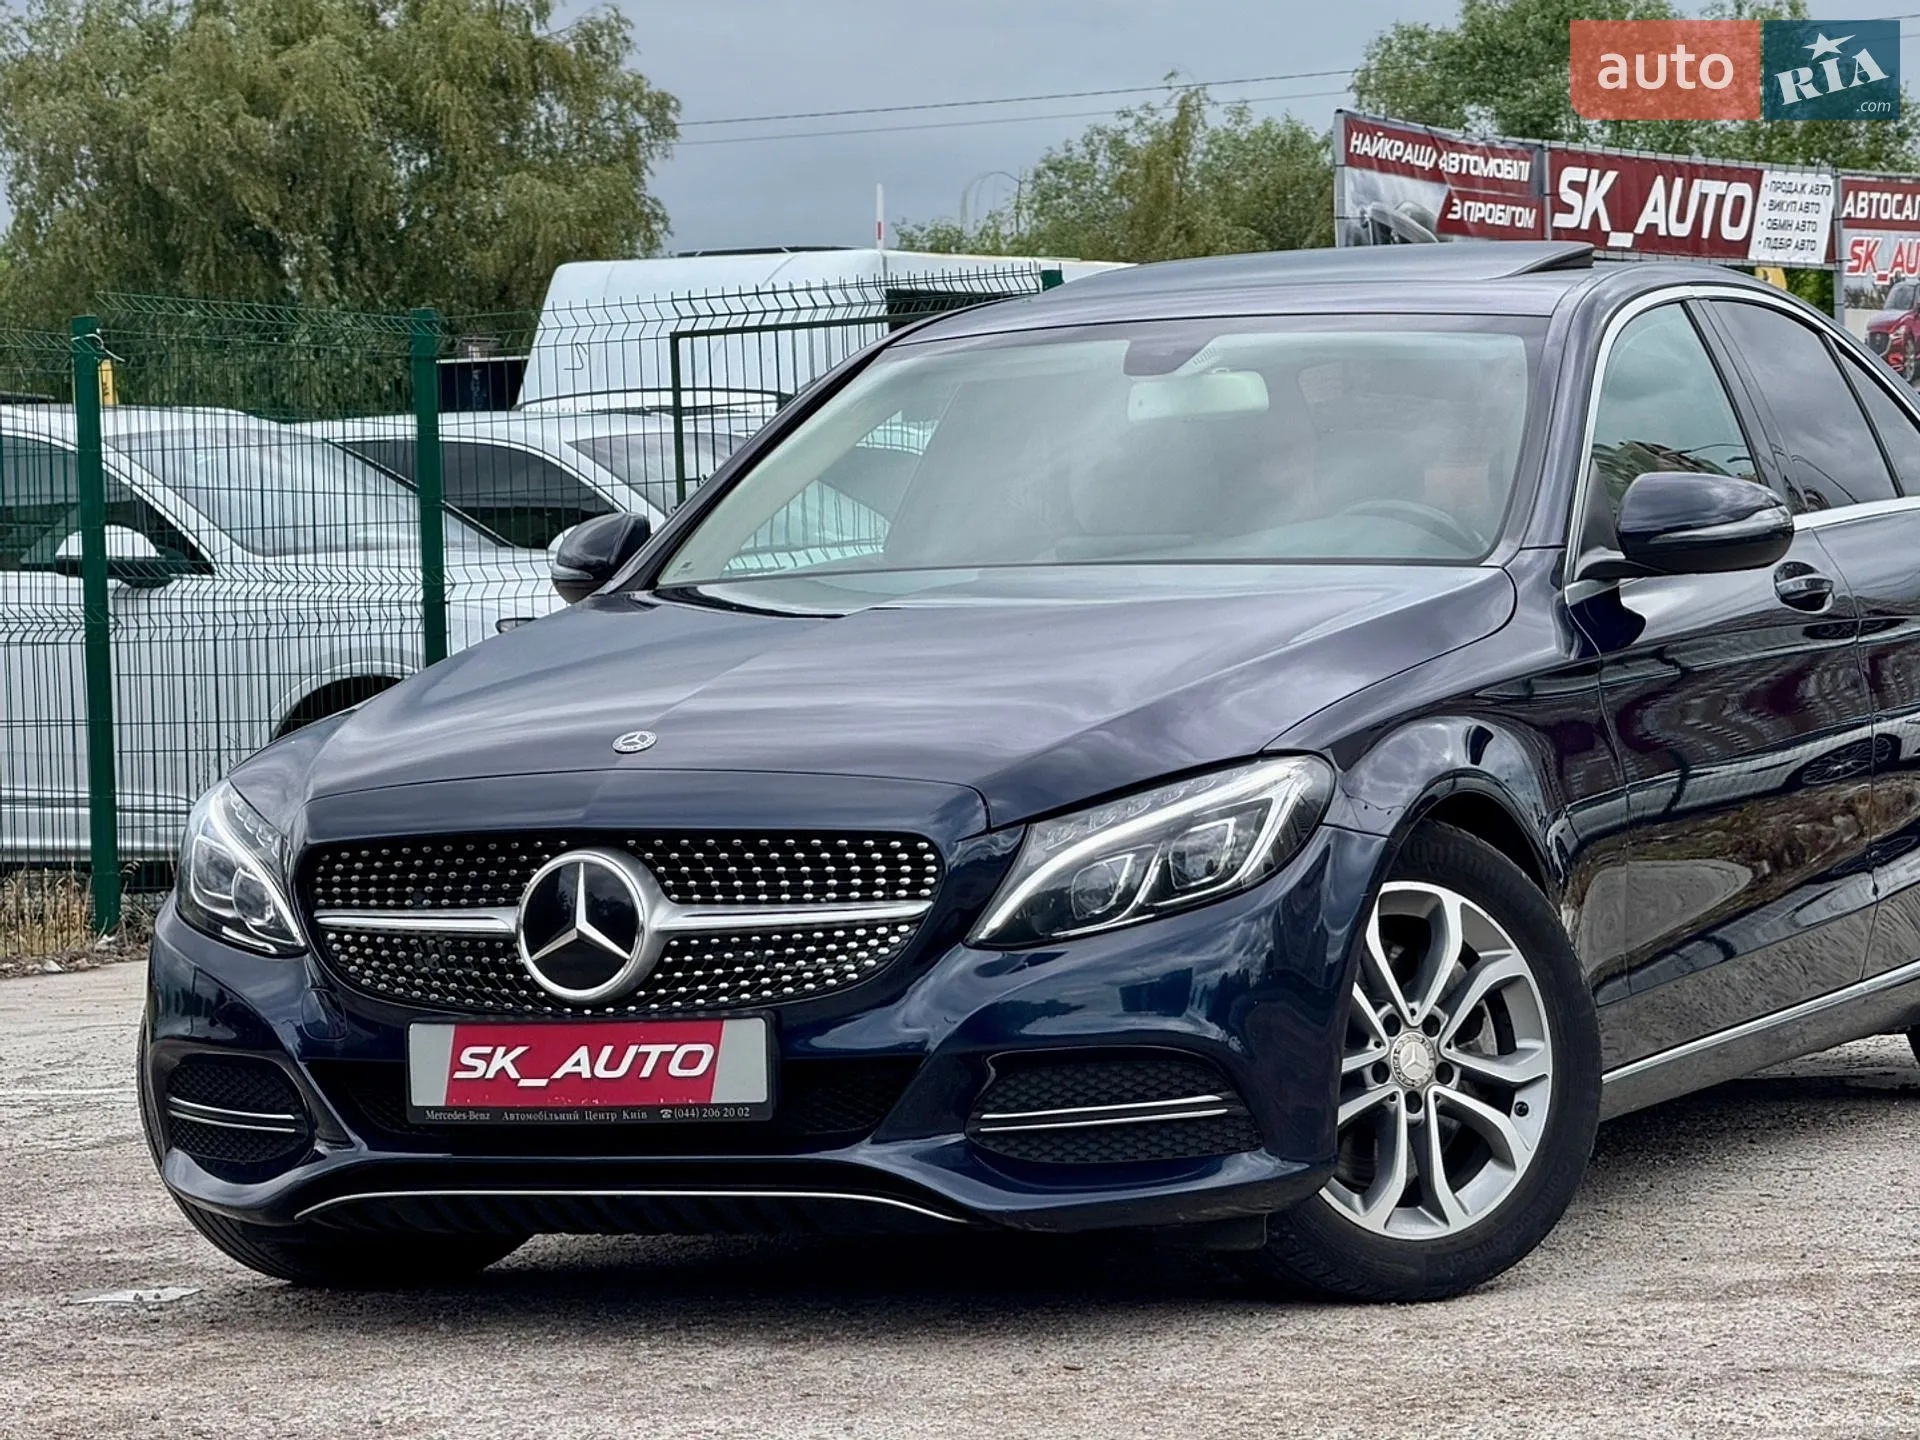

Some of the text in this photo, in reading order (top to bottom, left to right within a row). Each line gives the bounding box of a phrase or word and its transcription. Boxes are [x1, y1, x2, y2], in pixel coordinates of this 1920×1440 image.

[1769, 180, 1831, 196] ПРОДАЖ АВТО
[1463, 200, 1537, 228] ПРОБІГОМ
[1552, 166, 1753, 248] SK_AUTO
[1768, 199, 1820, 215] ВИКУП АВТО
[1766, 218, 1817, 233] ОБМІН АВТО
[1763, 237, 1817, 252] ПІДБІР АВТО
[452, 1043, 714, 1087] SK_AUTO
[425, 1106, 750, 1122] Mercedes-Benz Автомобільний Центр Київ (044) 206 20 02
